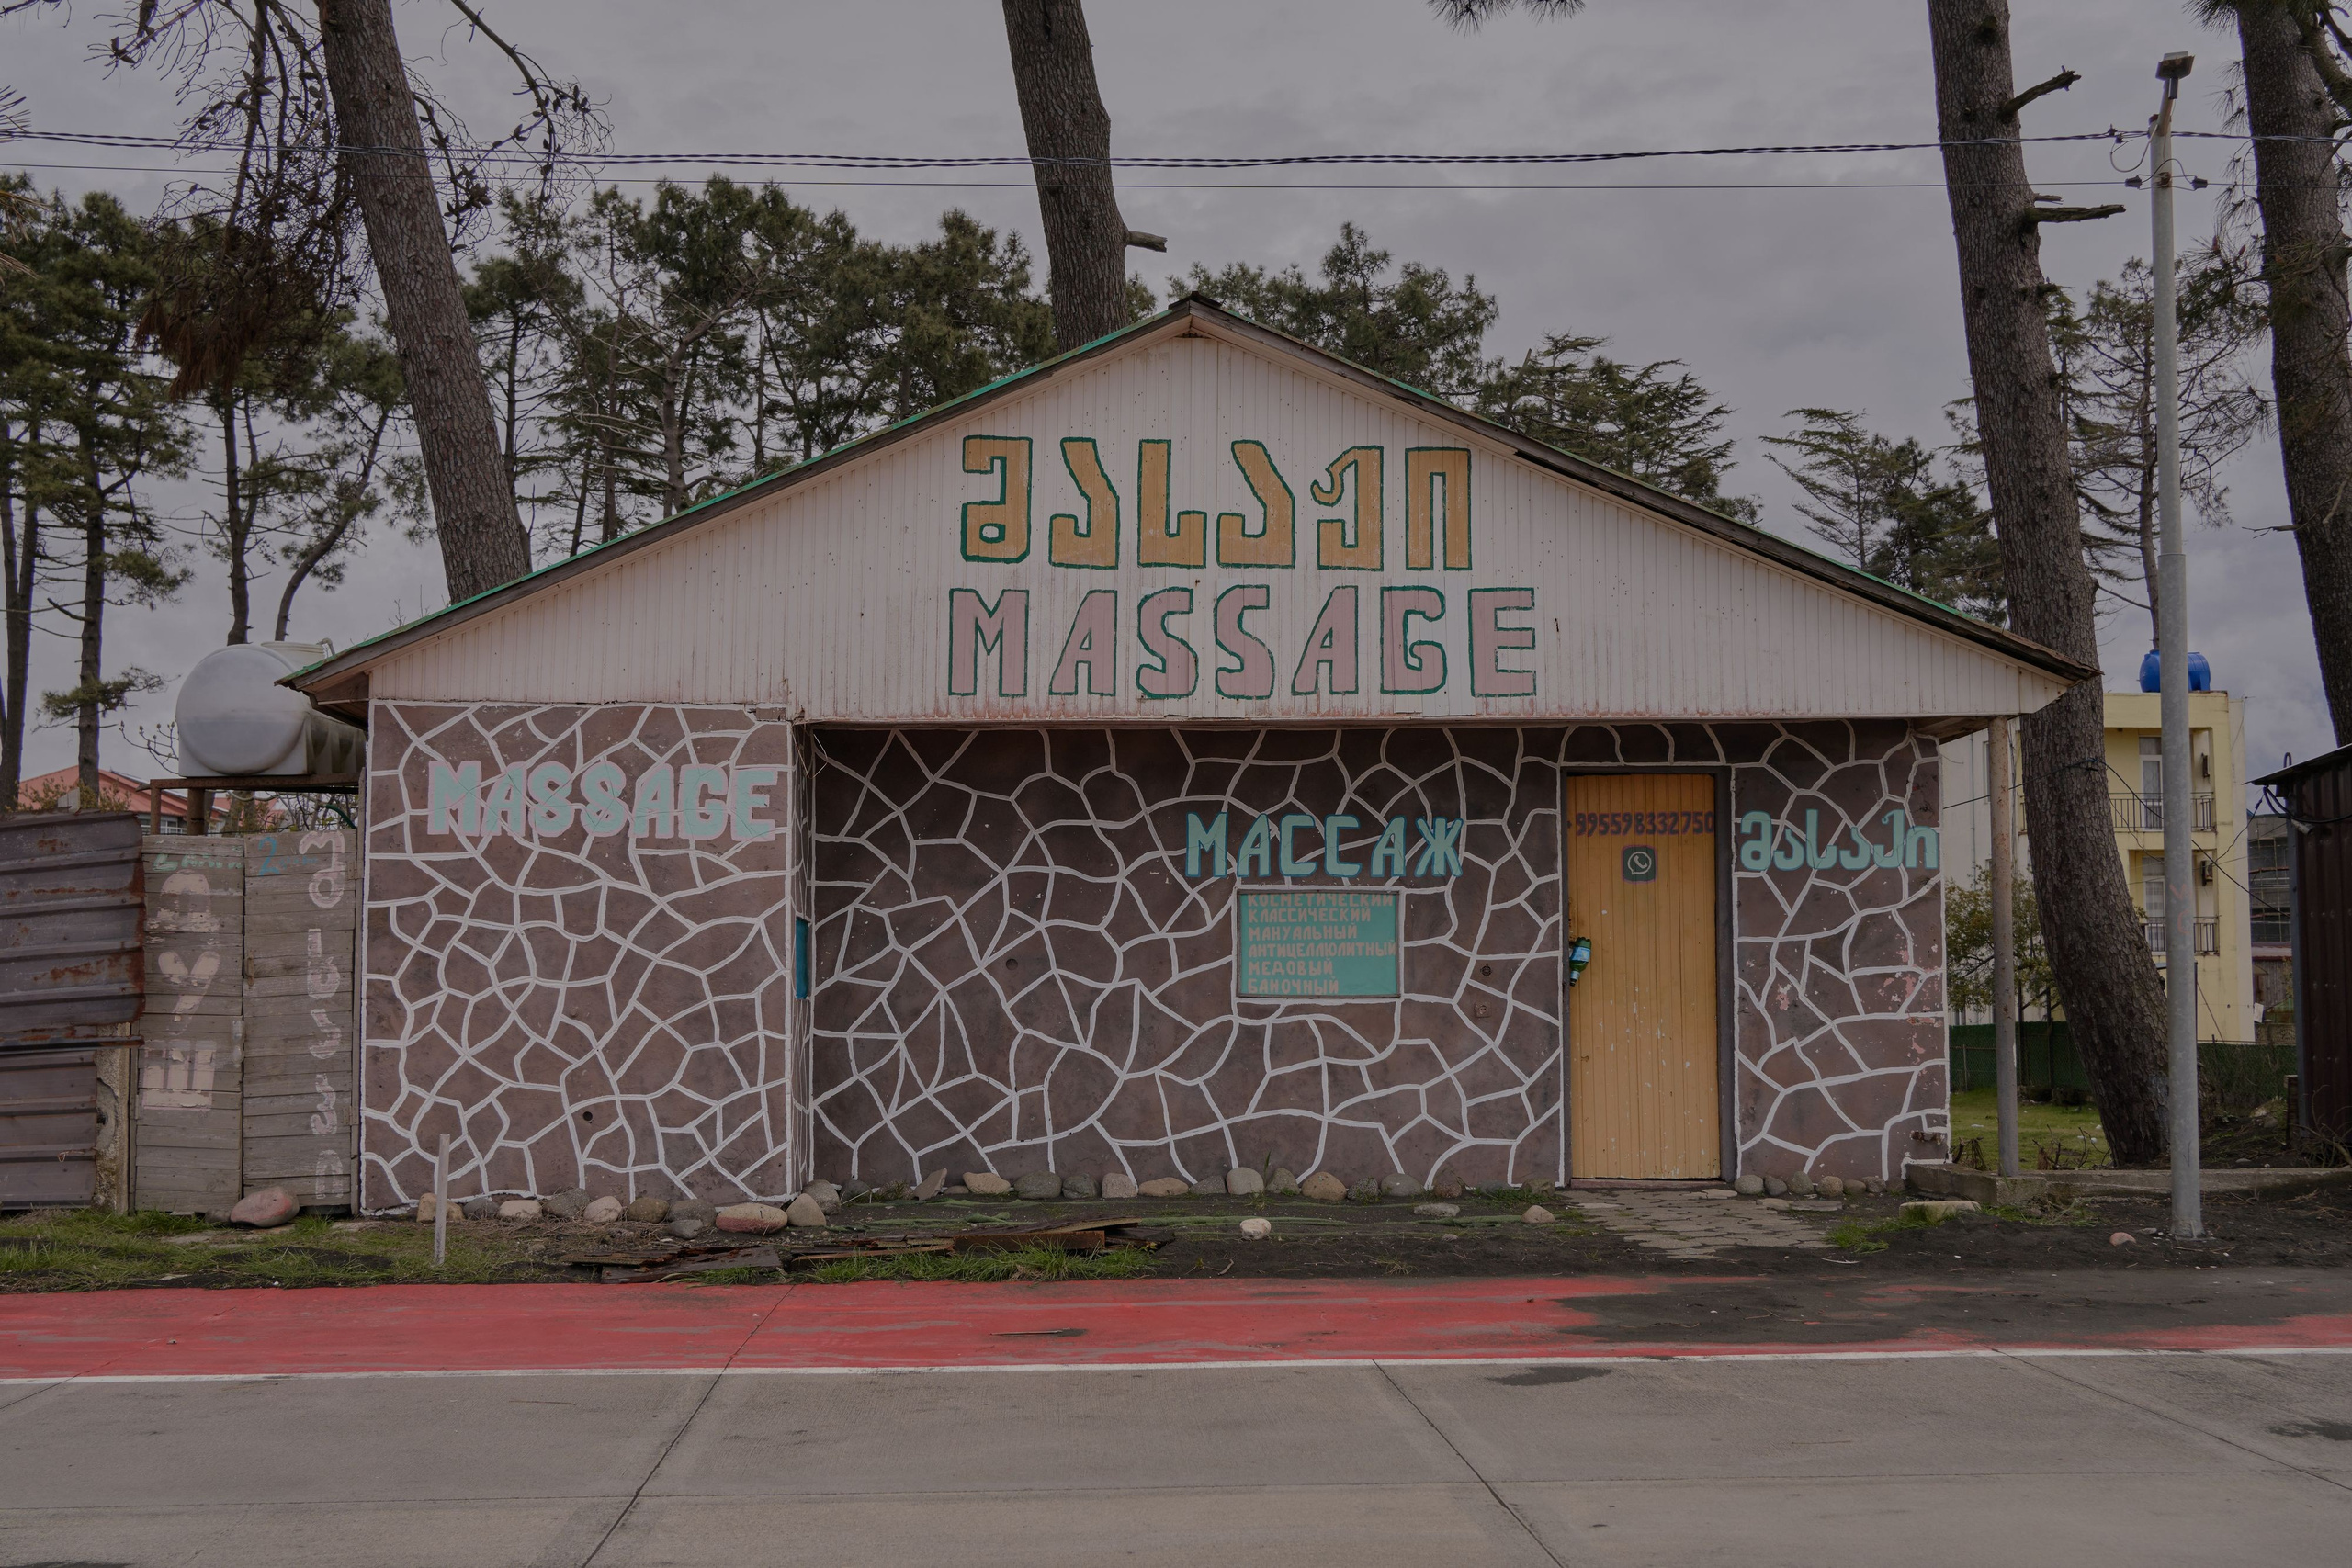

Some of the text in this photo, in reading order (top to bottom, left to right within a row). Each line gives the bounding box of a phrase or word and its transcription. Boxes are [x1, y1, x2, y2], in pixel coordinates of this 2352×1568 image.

[960, 434, 1473, 571] მასაჟი
[948, 583, 1536, 700] MASSAGE
[426, 760, 778, 841] MASSAGE
[1185, 811, 1464, 878] МАССАЖ
[1739, 808, 1939, 871] მასაჟი
[1248, 907, 1371, 923] КЛАССИЧЕСКИЙ
[1249, 923, 1358, 941] МАНУАЛЬНЫЙ
[1248, 958, 1333, 976] МЕДОВЫЙ
[1249, 940, 1396, 958] АНТИЦЕЛЛЮЛИТНЫЙ
[1248, 976, 1339, 995] БАНОЧНЫЙ
